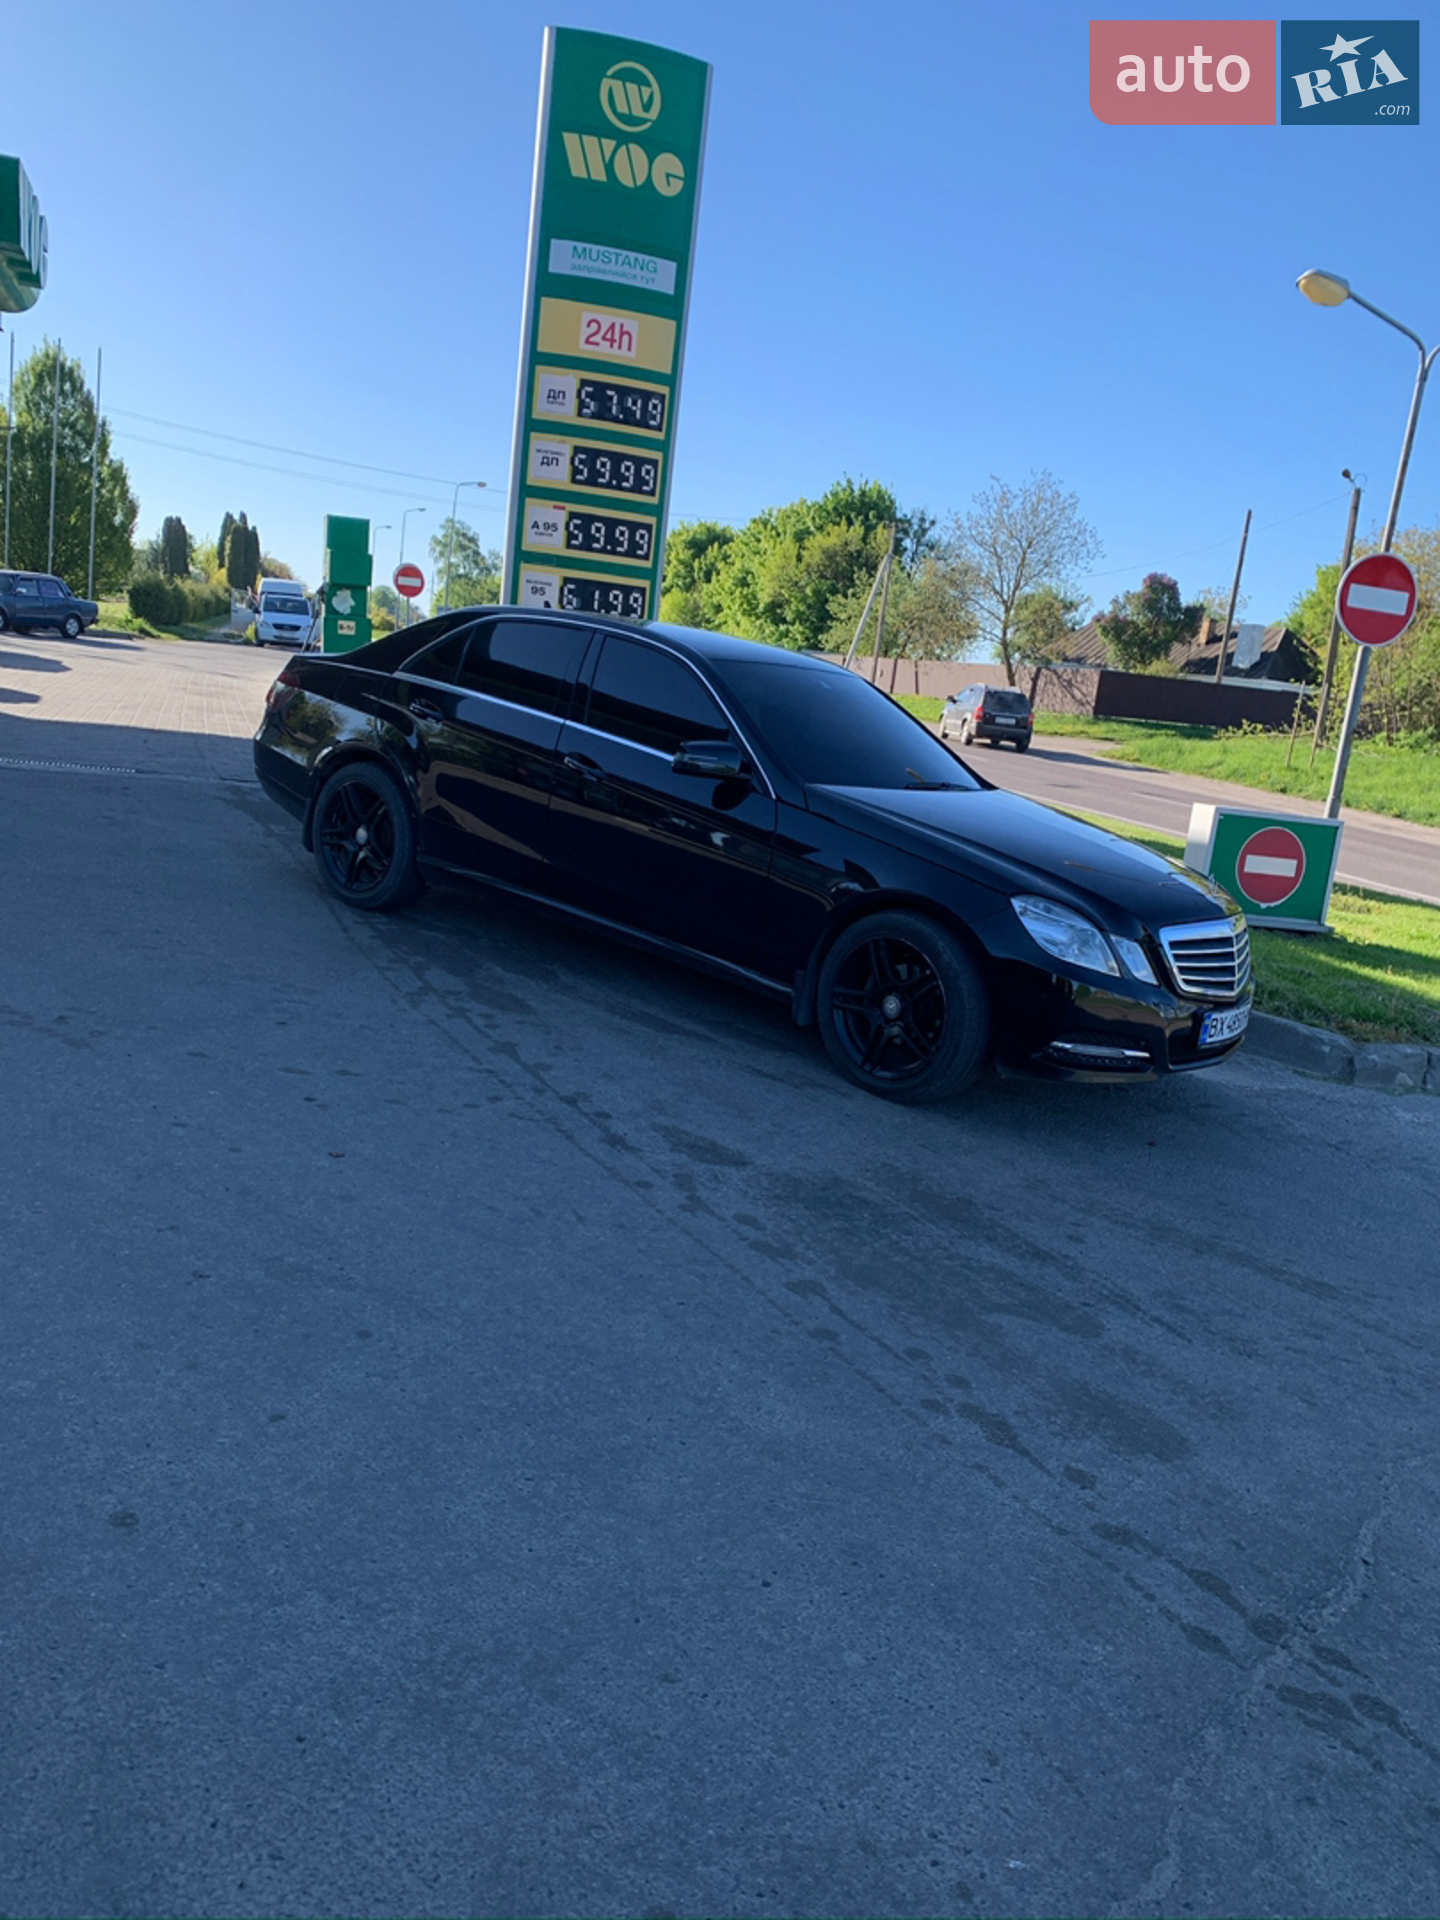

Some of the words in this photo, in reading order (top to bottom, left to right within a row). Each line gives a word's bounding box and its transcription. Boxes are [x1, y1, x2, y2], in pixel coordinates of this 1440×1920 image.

[562, 131, 685, 197] WOG
[572, 245, 659, 275] MUSTANG
[584, 318, 633, 352] 24h
[581, 386, 662, 426] 57.49
[574, 453, 655, 491] 59.99
[569, 519, 649, 555] 59.99
[563, 584, 643, 618] 61.99
